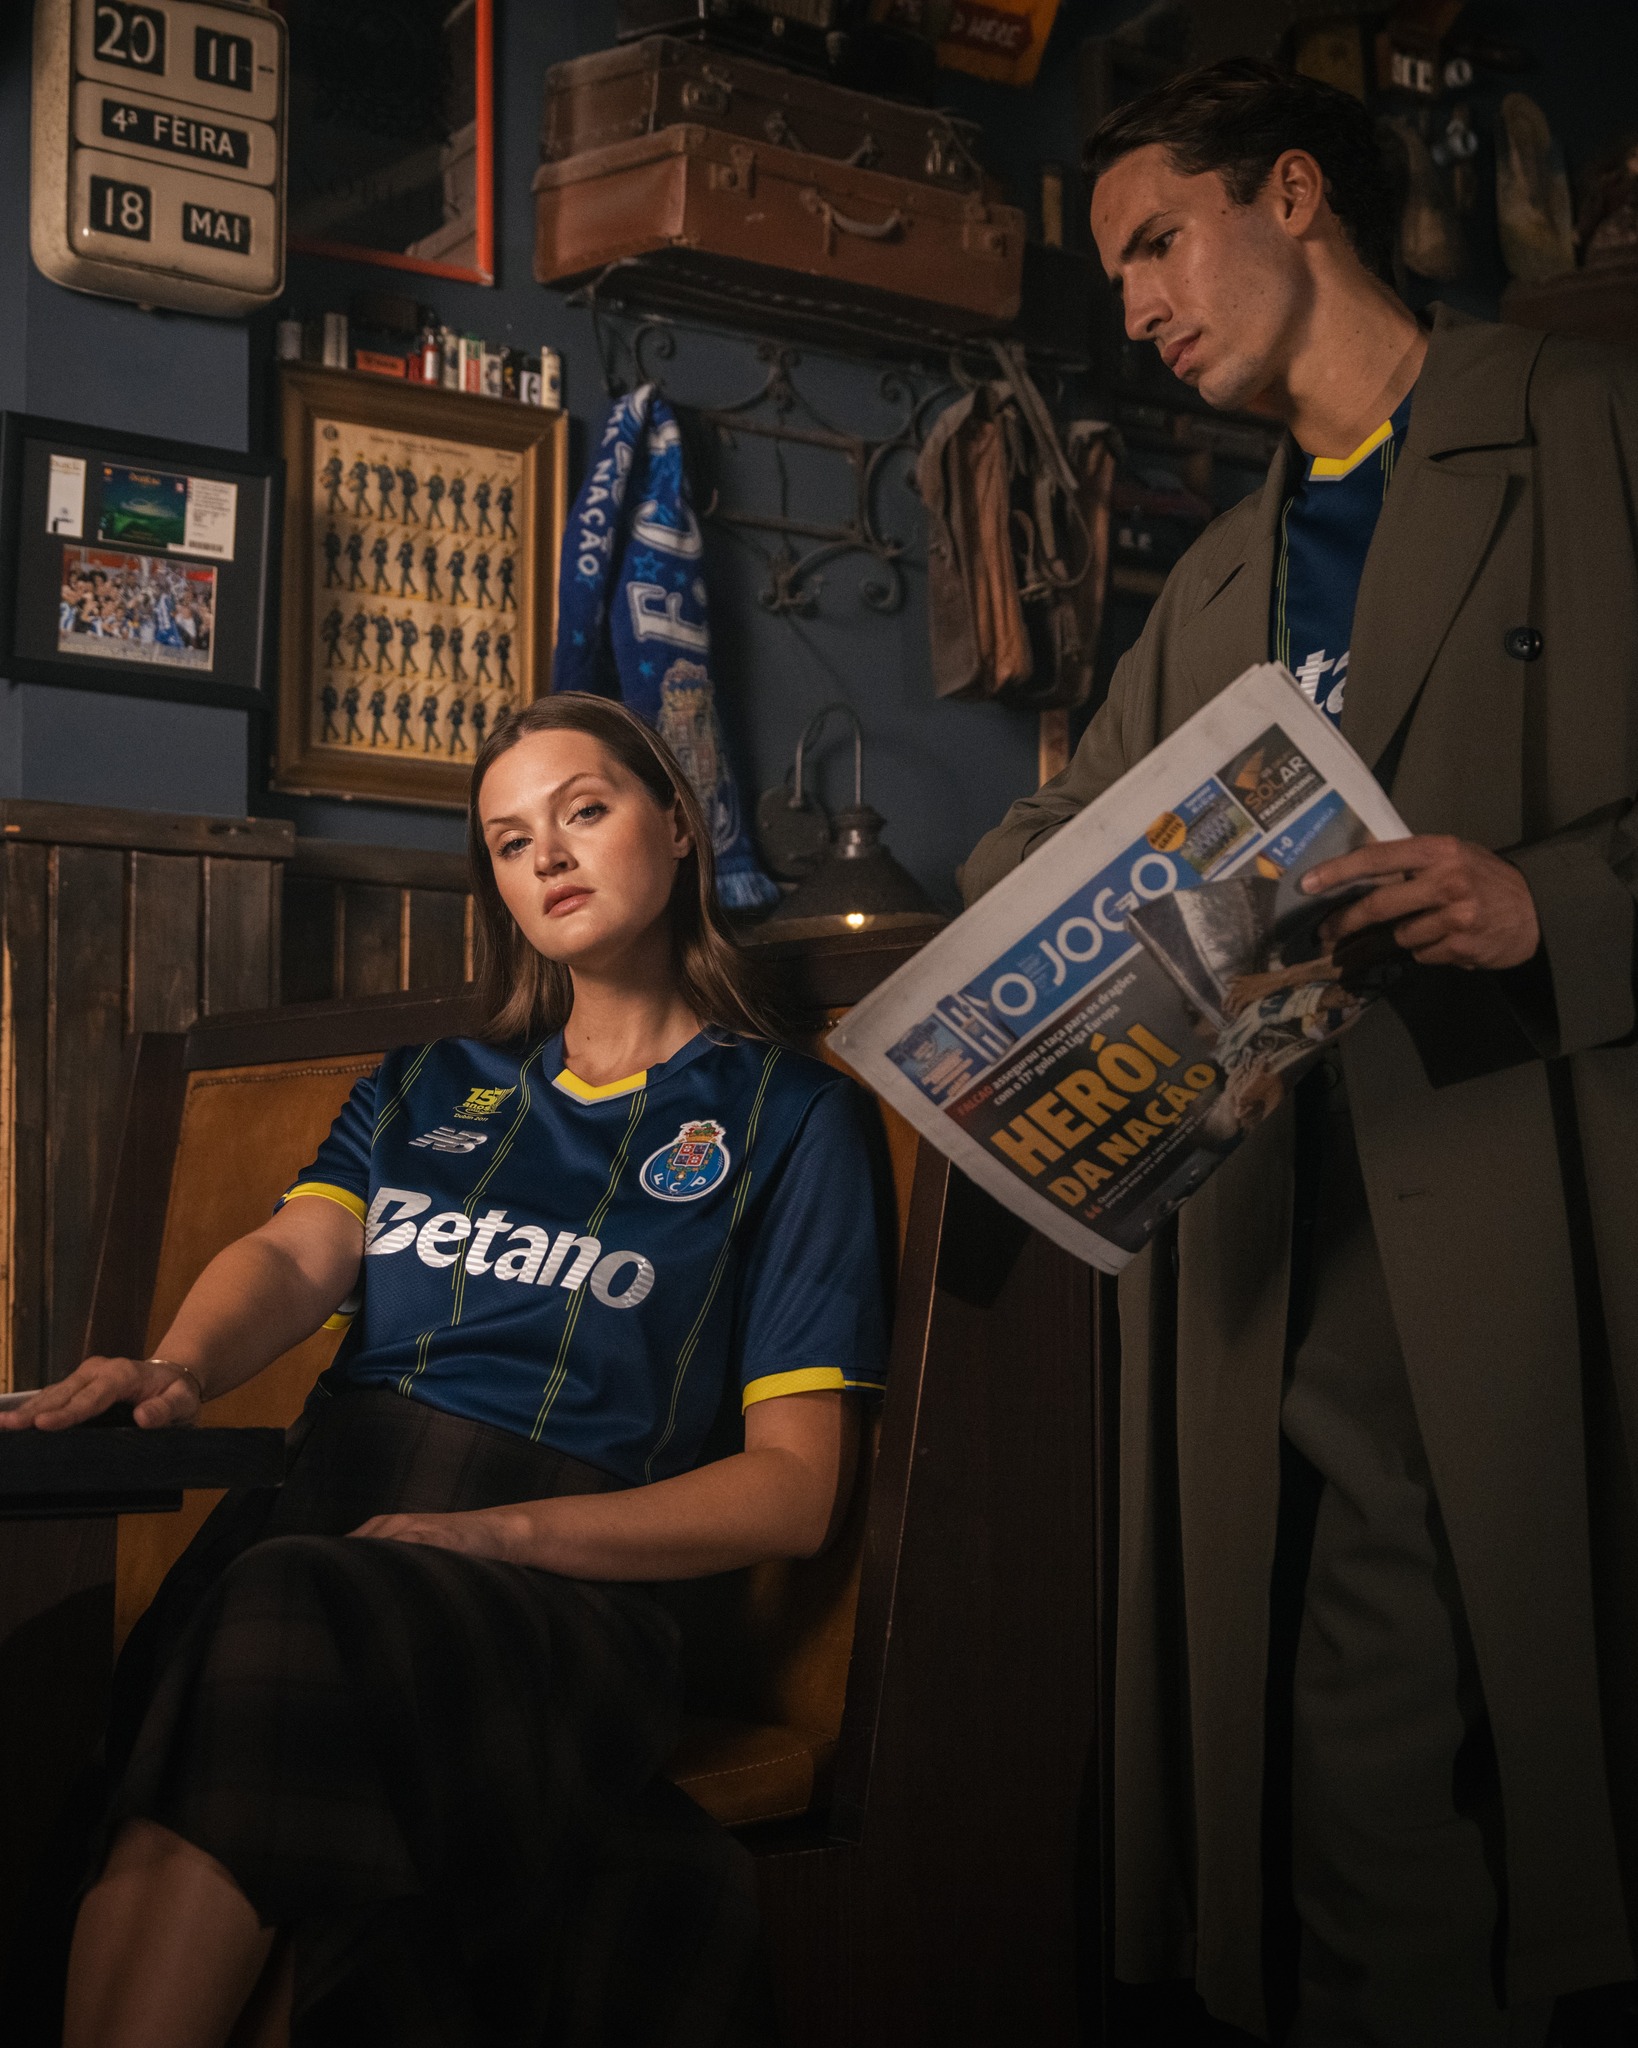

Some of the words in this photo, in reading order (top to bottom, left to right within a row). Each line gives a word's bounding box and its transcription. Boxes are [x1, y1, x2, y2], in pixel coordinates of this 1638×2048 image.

[97, 6, 156, 64] 20
[208, 37, 237, 82] 11
[111, 107, 138, 132] 4ª
[153, 115, 235, 158] FEIRA
[105, 186, 144, 231] 18
[190, 207, 240, 244] MAI
[1242, 753, 1307, 808] SOLAR
[1271, 836, 1292, 857] 1-0
[992, 972, 1036, 1016] O
[1038, 853, 1177, 985] JOGO
[990, 1048, 1041, 1092] assegurou
[1036, 1043, 1047, 1053] a
[1042, 1026, 1068, 1050] taça
[1063, 1010, 1088, 1033] para
[1085, 1000, 1100, 1014] os
[1095, 969, 1138, 1007] dragões
[992, 1086, 1015, 1107] com
[1012, 1080, 1023, 1091] o
[1032, 1053, 1058, 1077] golo
[1053, 1044, 1068, 1059] na
[1065, 1027, 1090, 1051] Liga
[1084, 1001, 1121, 1034] Europa
[453, 1113, 475, 1121] Dublin
[990, 1022, 1181, 1177] HERÓI
[1047, 1160, 1114, 1207] DA
[1097, 1061, 1215, 1165] NAÇÃO
[365, 1187, 656, 1310] Betano
